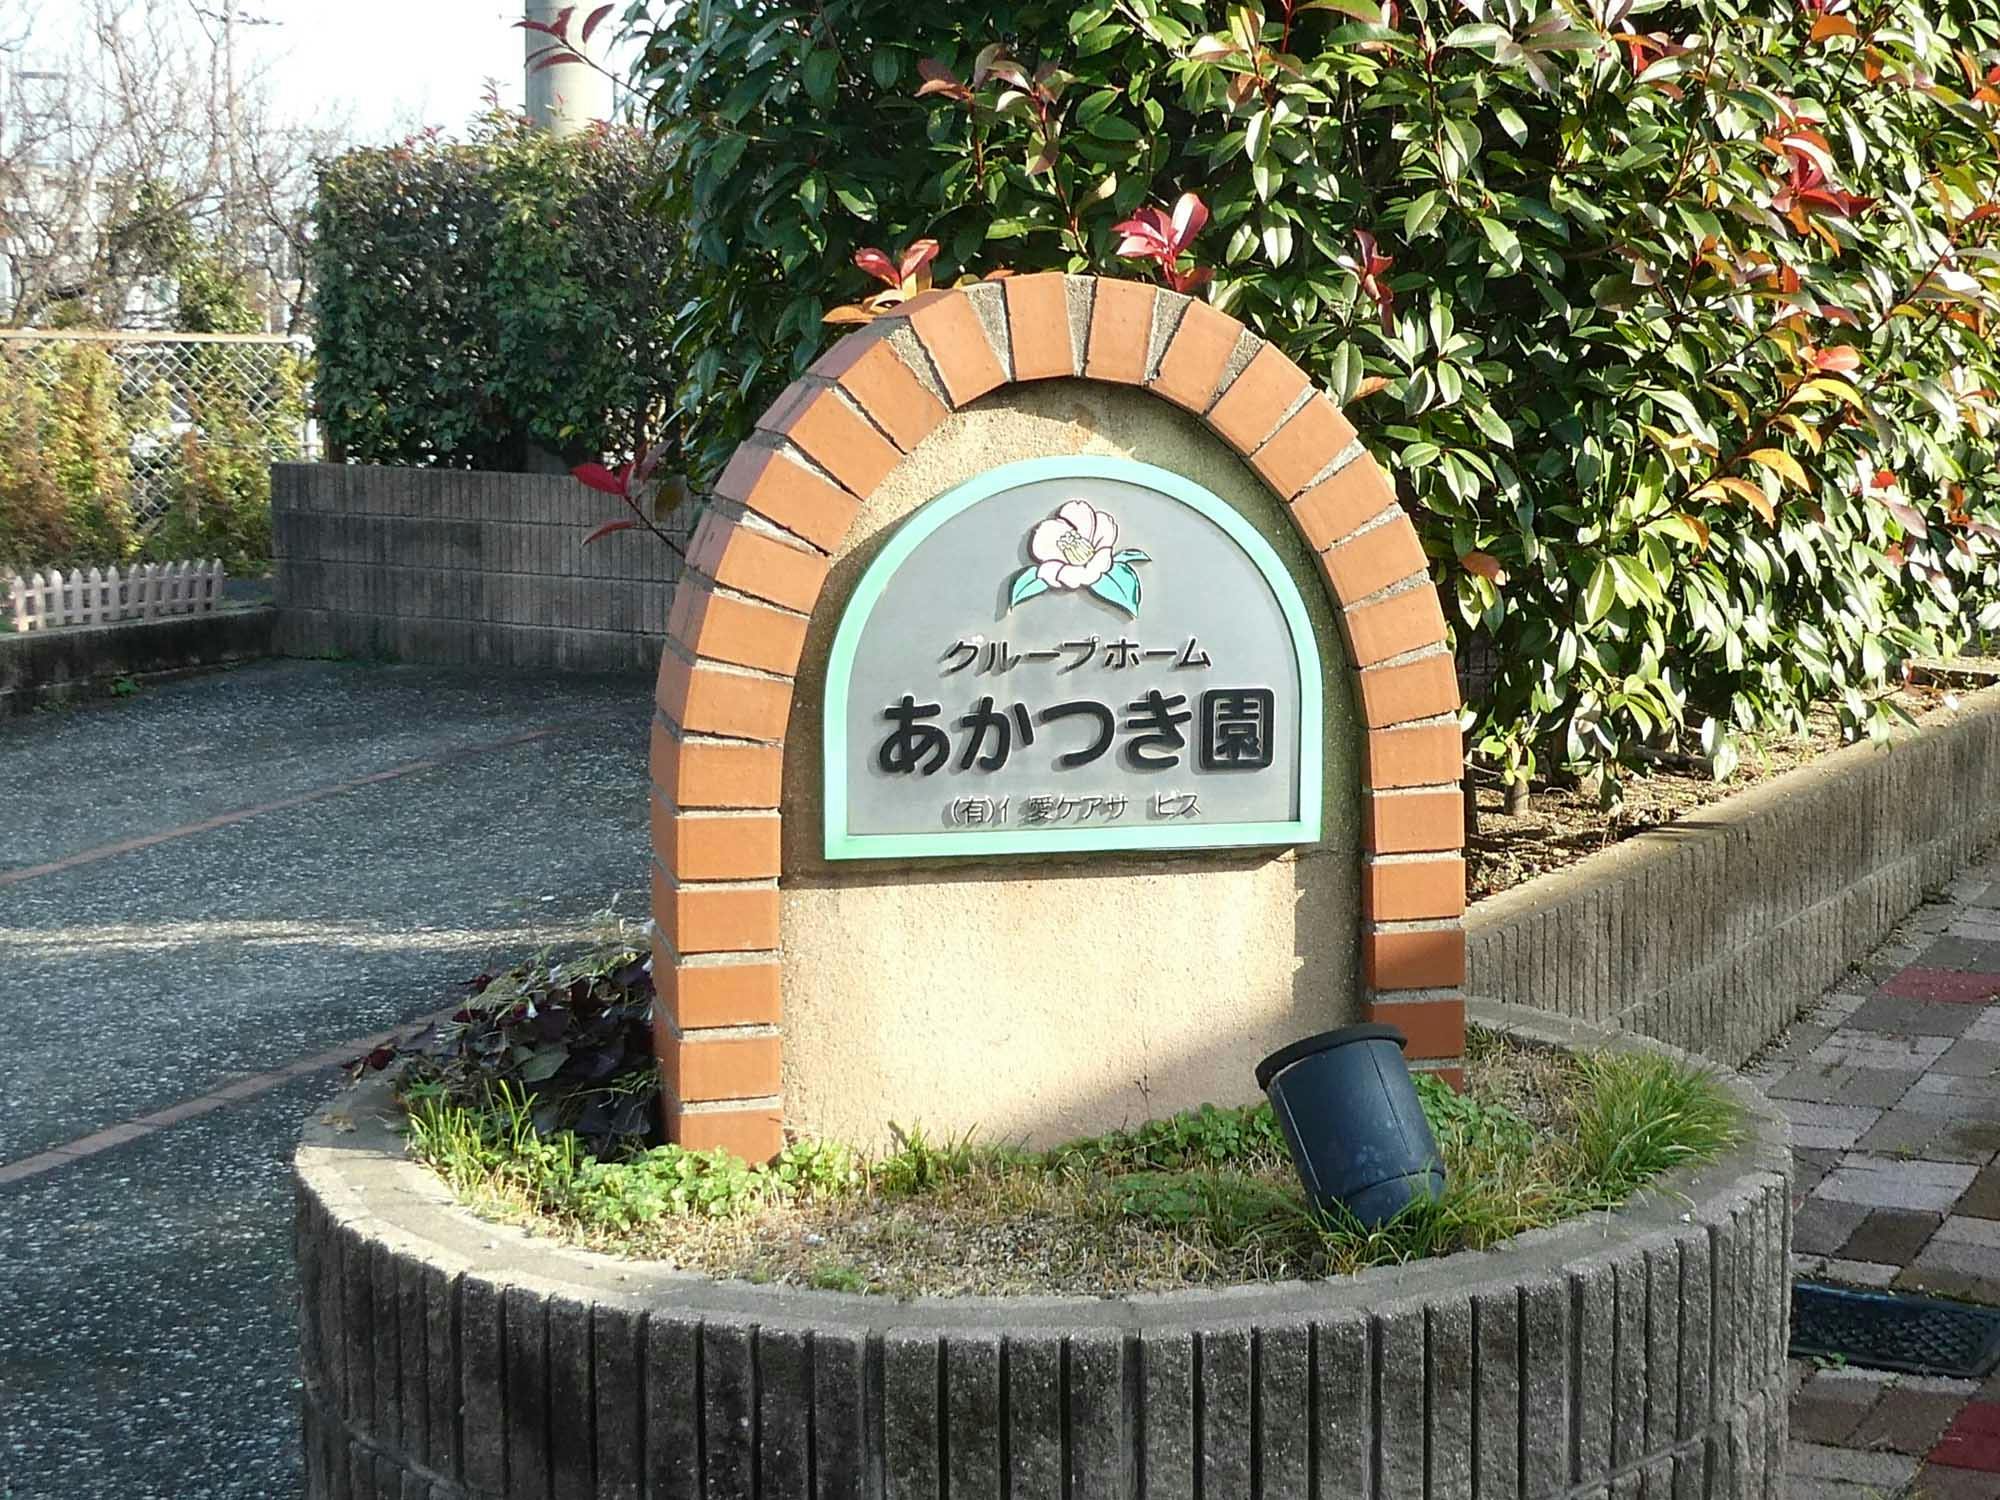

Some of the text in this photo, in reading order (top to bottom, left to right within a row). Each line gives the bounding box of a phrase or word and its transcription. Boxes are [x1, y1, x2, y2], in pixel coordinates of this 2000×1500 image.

[880, 688, 1275, 776] あかつき園
